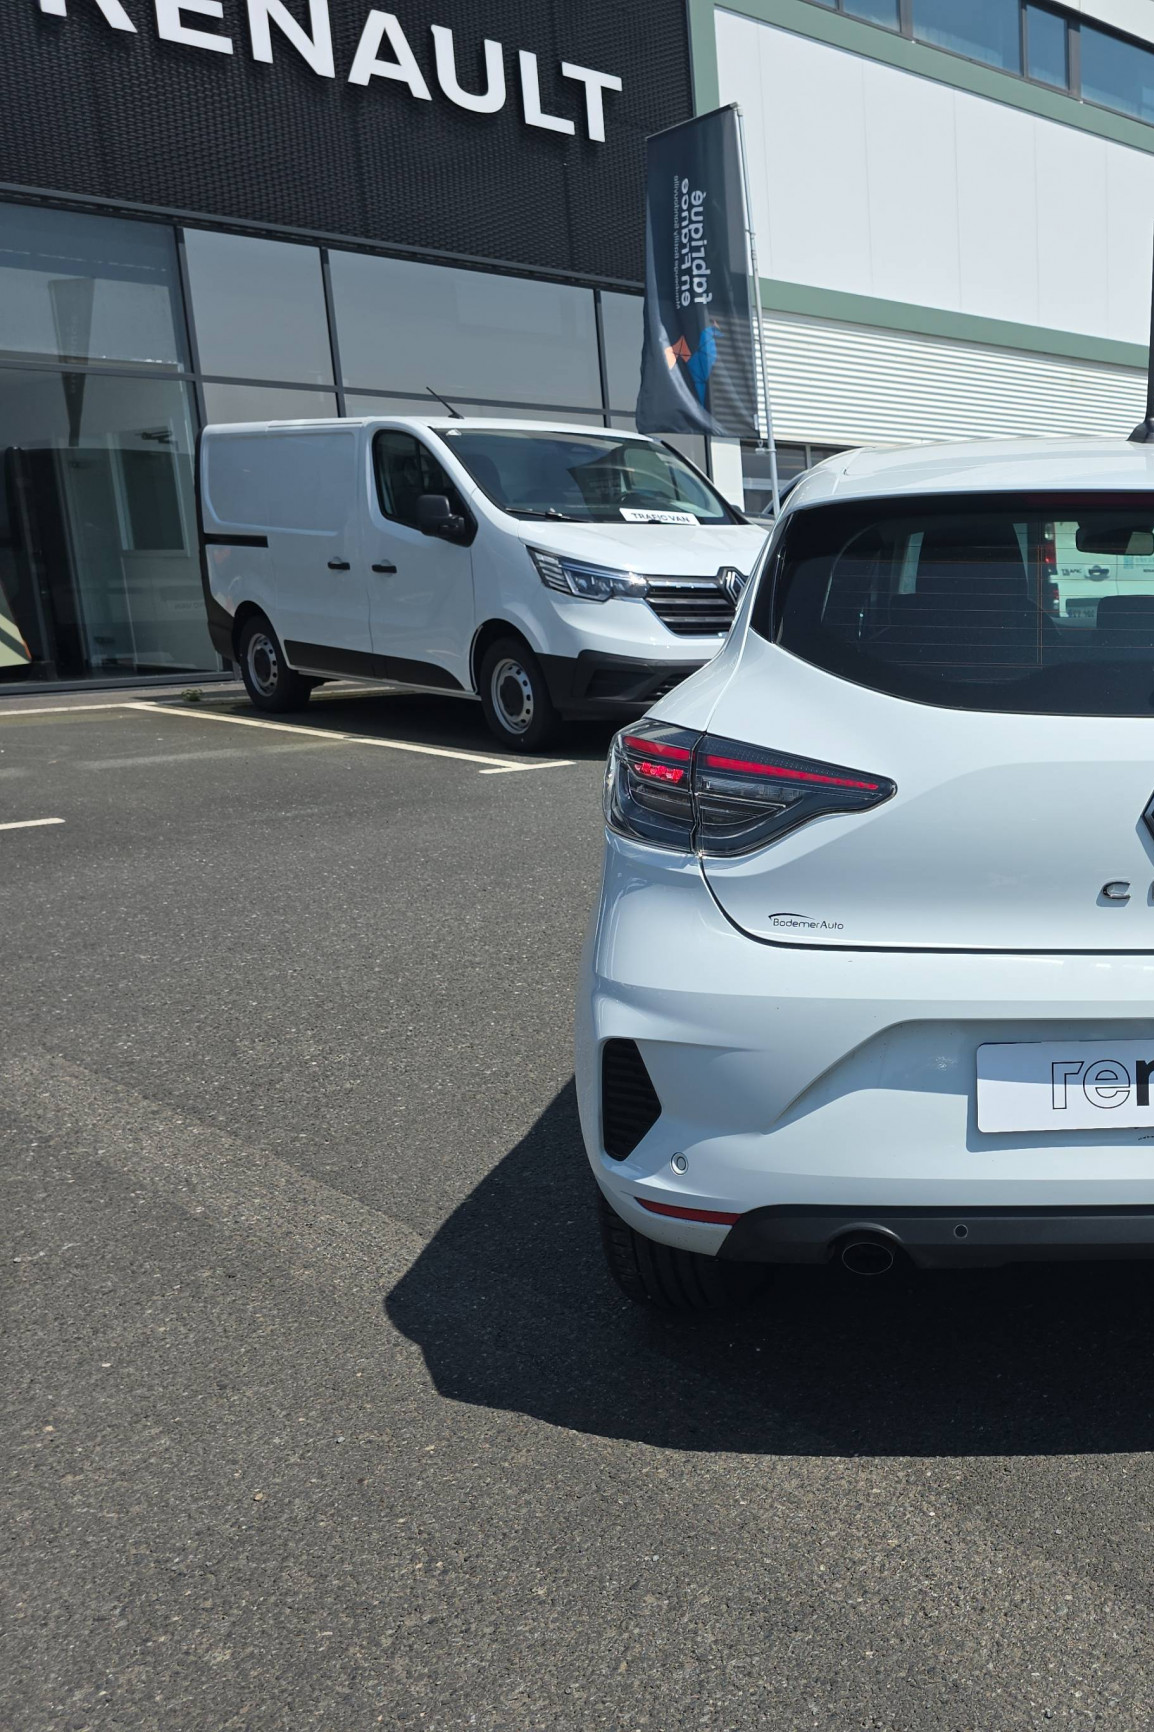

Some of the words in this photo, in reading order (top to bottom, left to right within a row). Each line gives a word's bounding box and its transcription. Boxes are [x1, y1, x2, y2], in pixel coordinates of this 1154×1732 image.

[40, 0, 623, 142] ENAULT
[631, 512, 668, 521] TRAFIC
[669, 514, 691, 523] VAN
